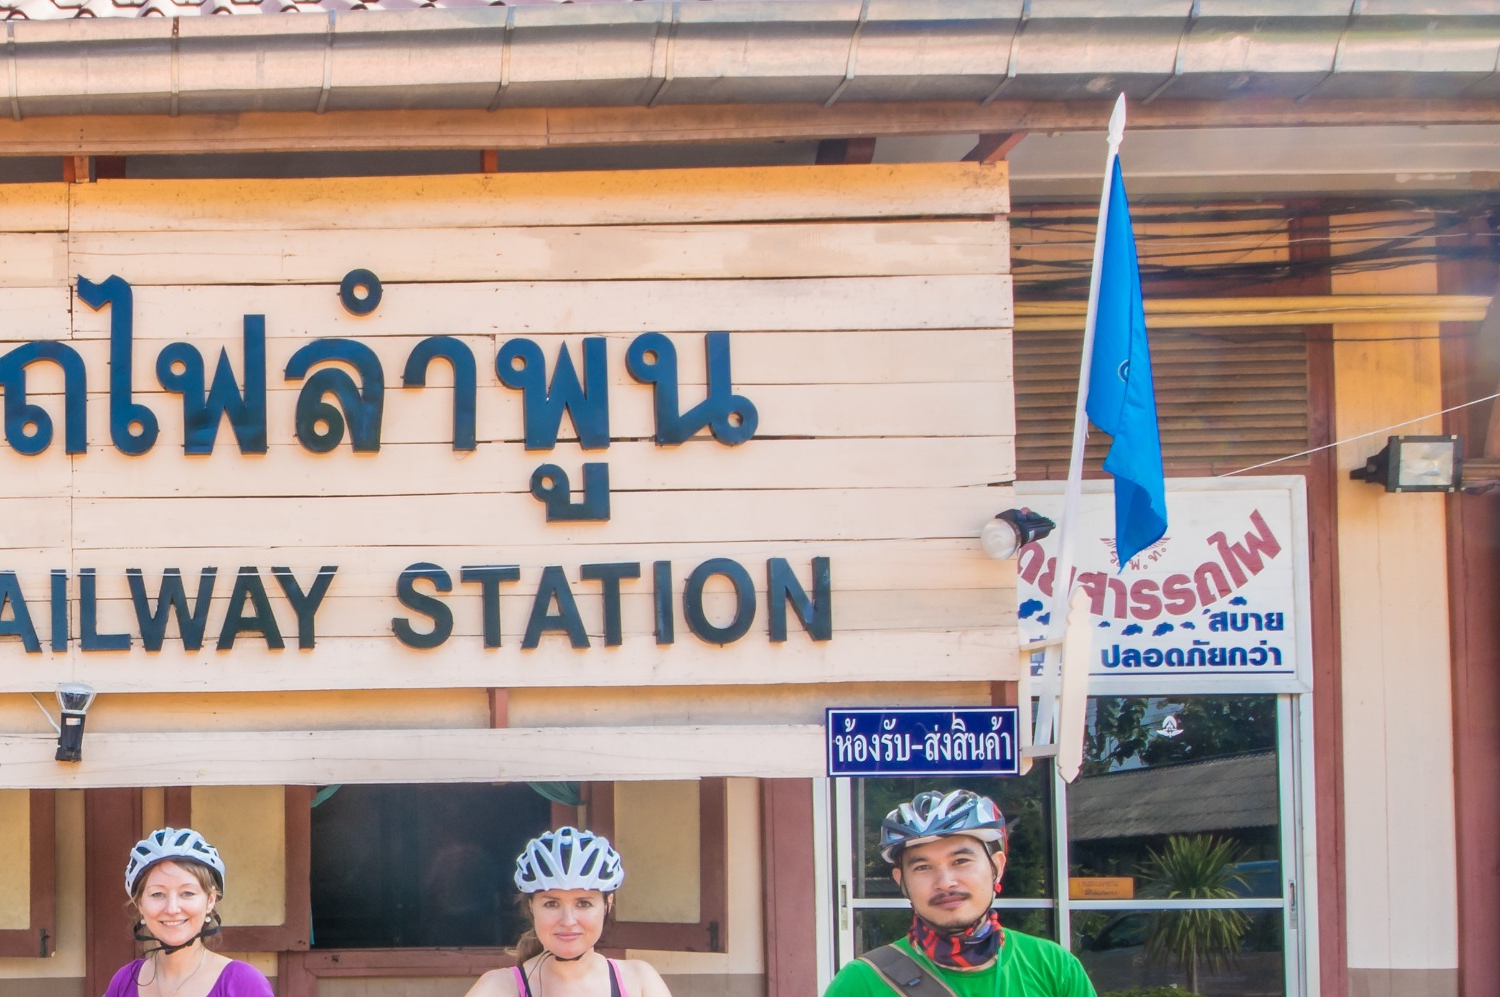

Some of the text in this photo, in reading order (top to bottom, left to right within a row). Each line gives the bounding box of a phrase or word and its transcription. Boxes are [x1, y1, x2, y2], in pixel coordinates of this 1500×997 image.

[392, 556, 833, 649] STATION
[1208, 610, 1284, 632] สบาย
[1100, 640, 1282, 668] ปลอดภัยกว่า
[835, 715, 1012, 762] ห้องรับ-ส่งสินค้า
